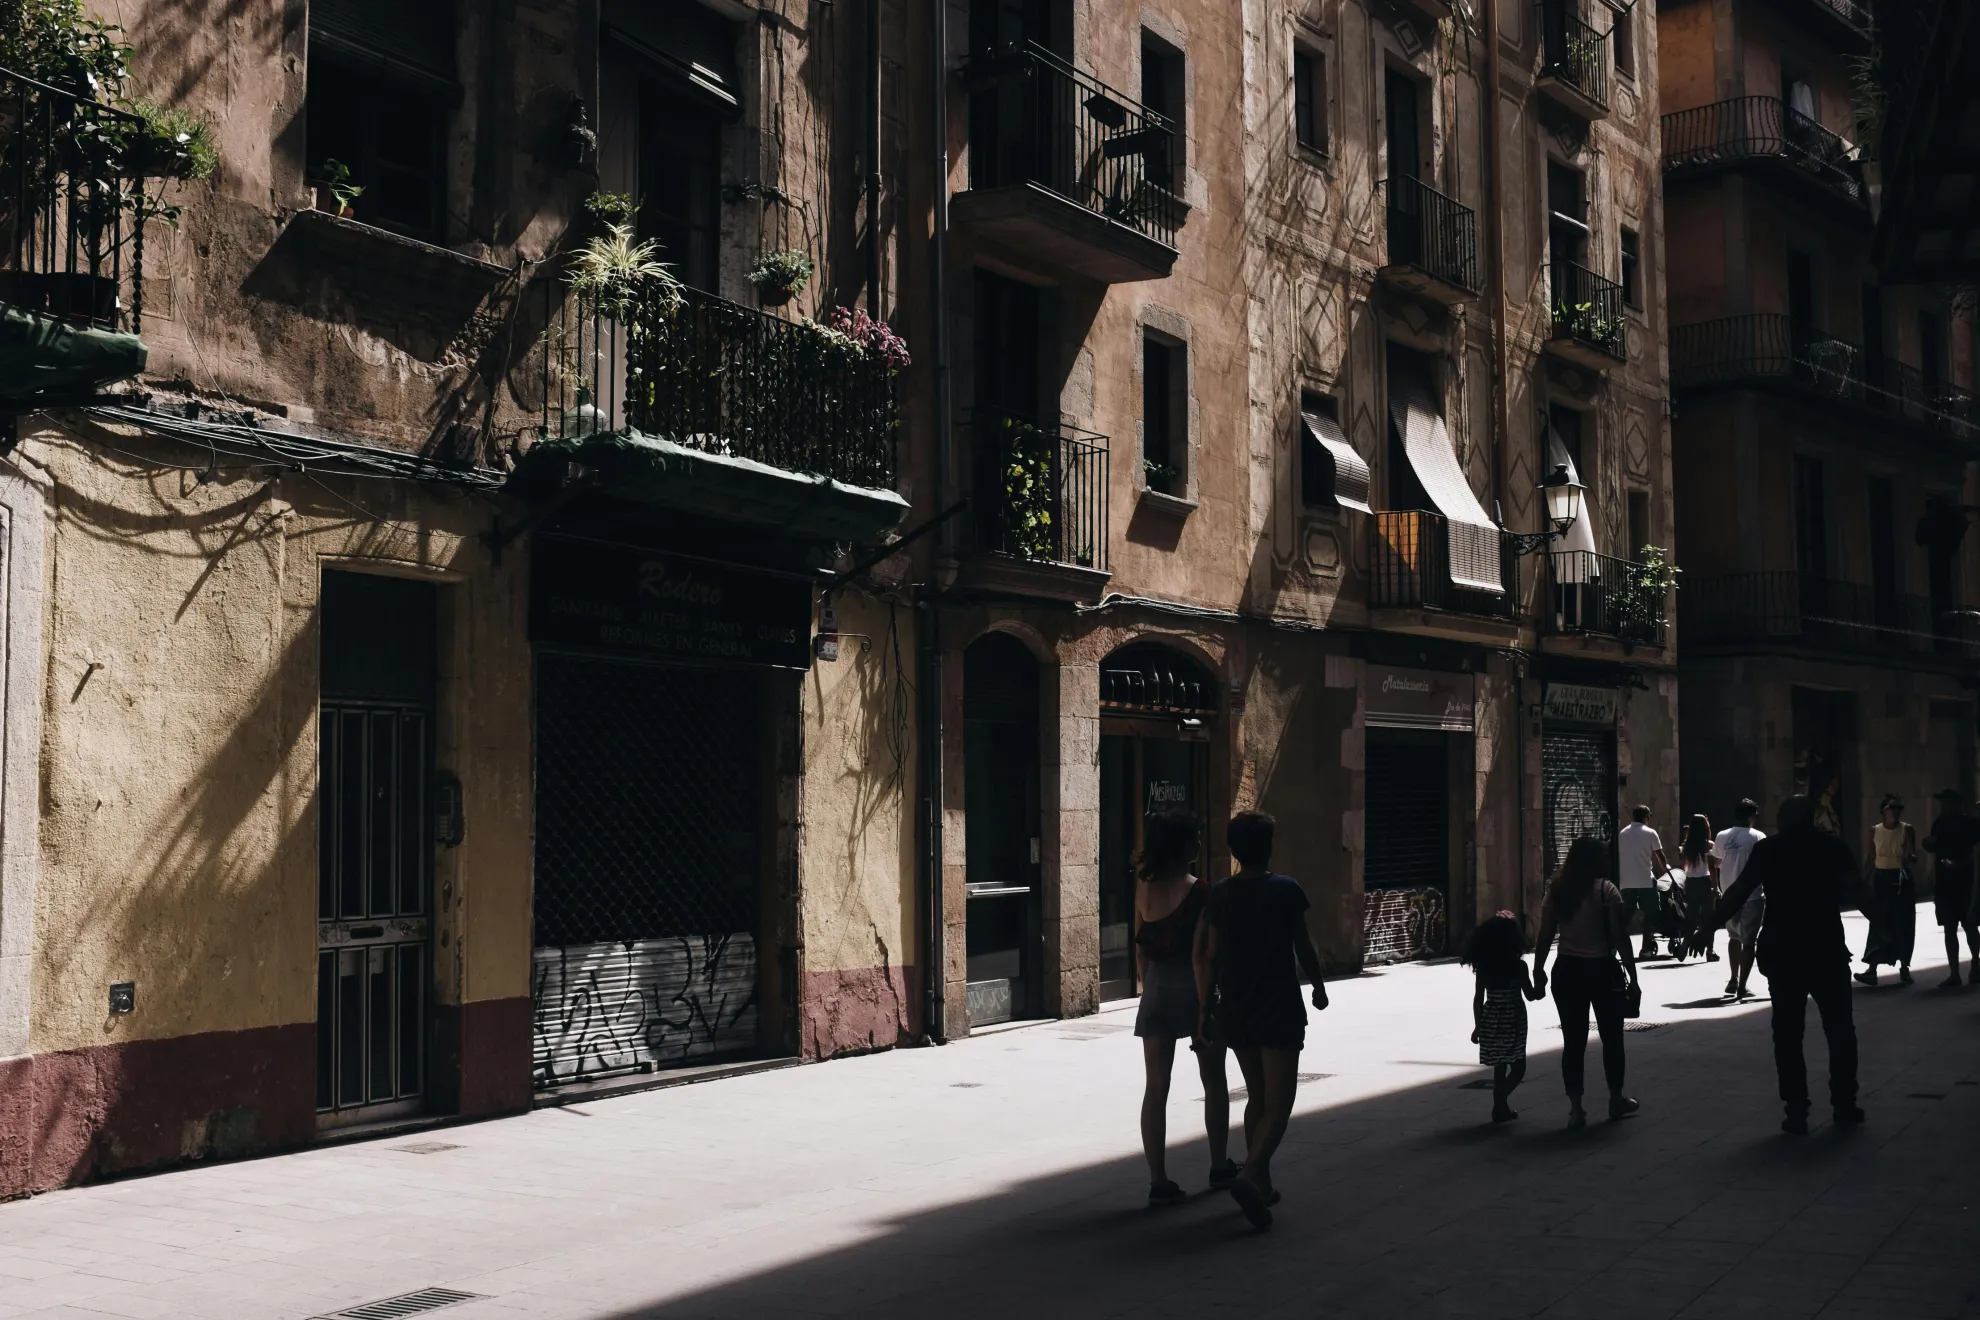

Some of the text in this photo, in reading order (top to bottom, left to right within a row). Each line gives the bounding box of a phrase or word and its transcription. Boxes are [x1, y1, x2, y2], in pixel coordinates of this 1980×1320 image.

[638, 561, 722, 605] Rodero
[600, 625, 752, 658] REFORMES EN GENERAL
[702, 617, 743, 637] BANYS
[757, 624, 796, 645] CUINES
